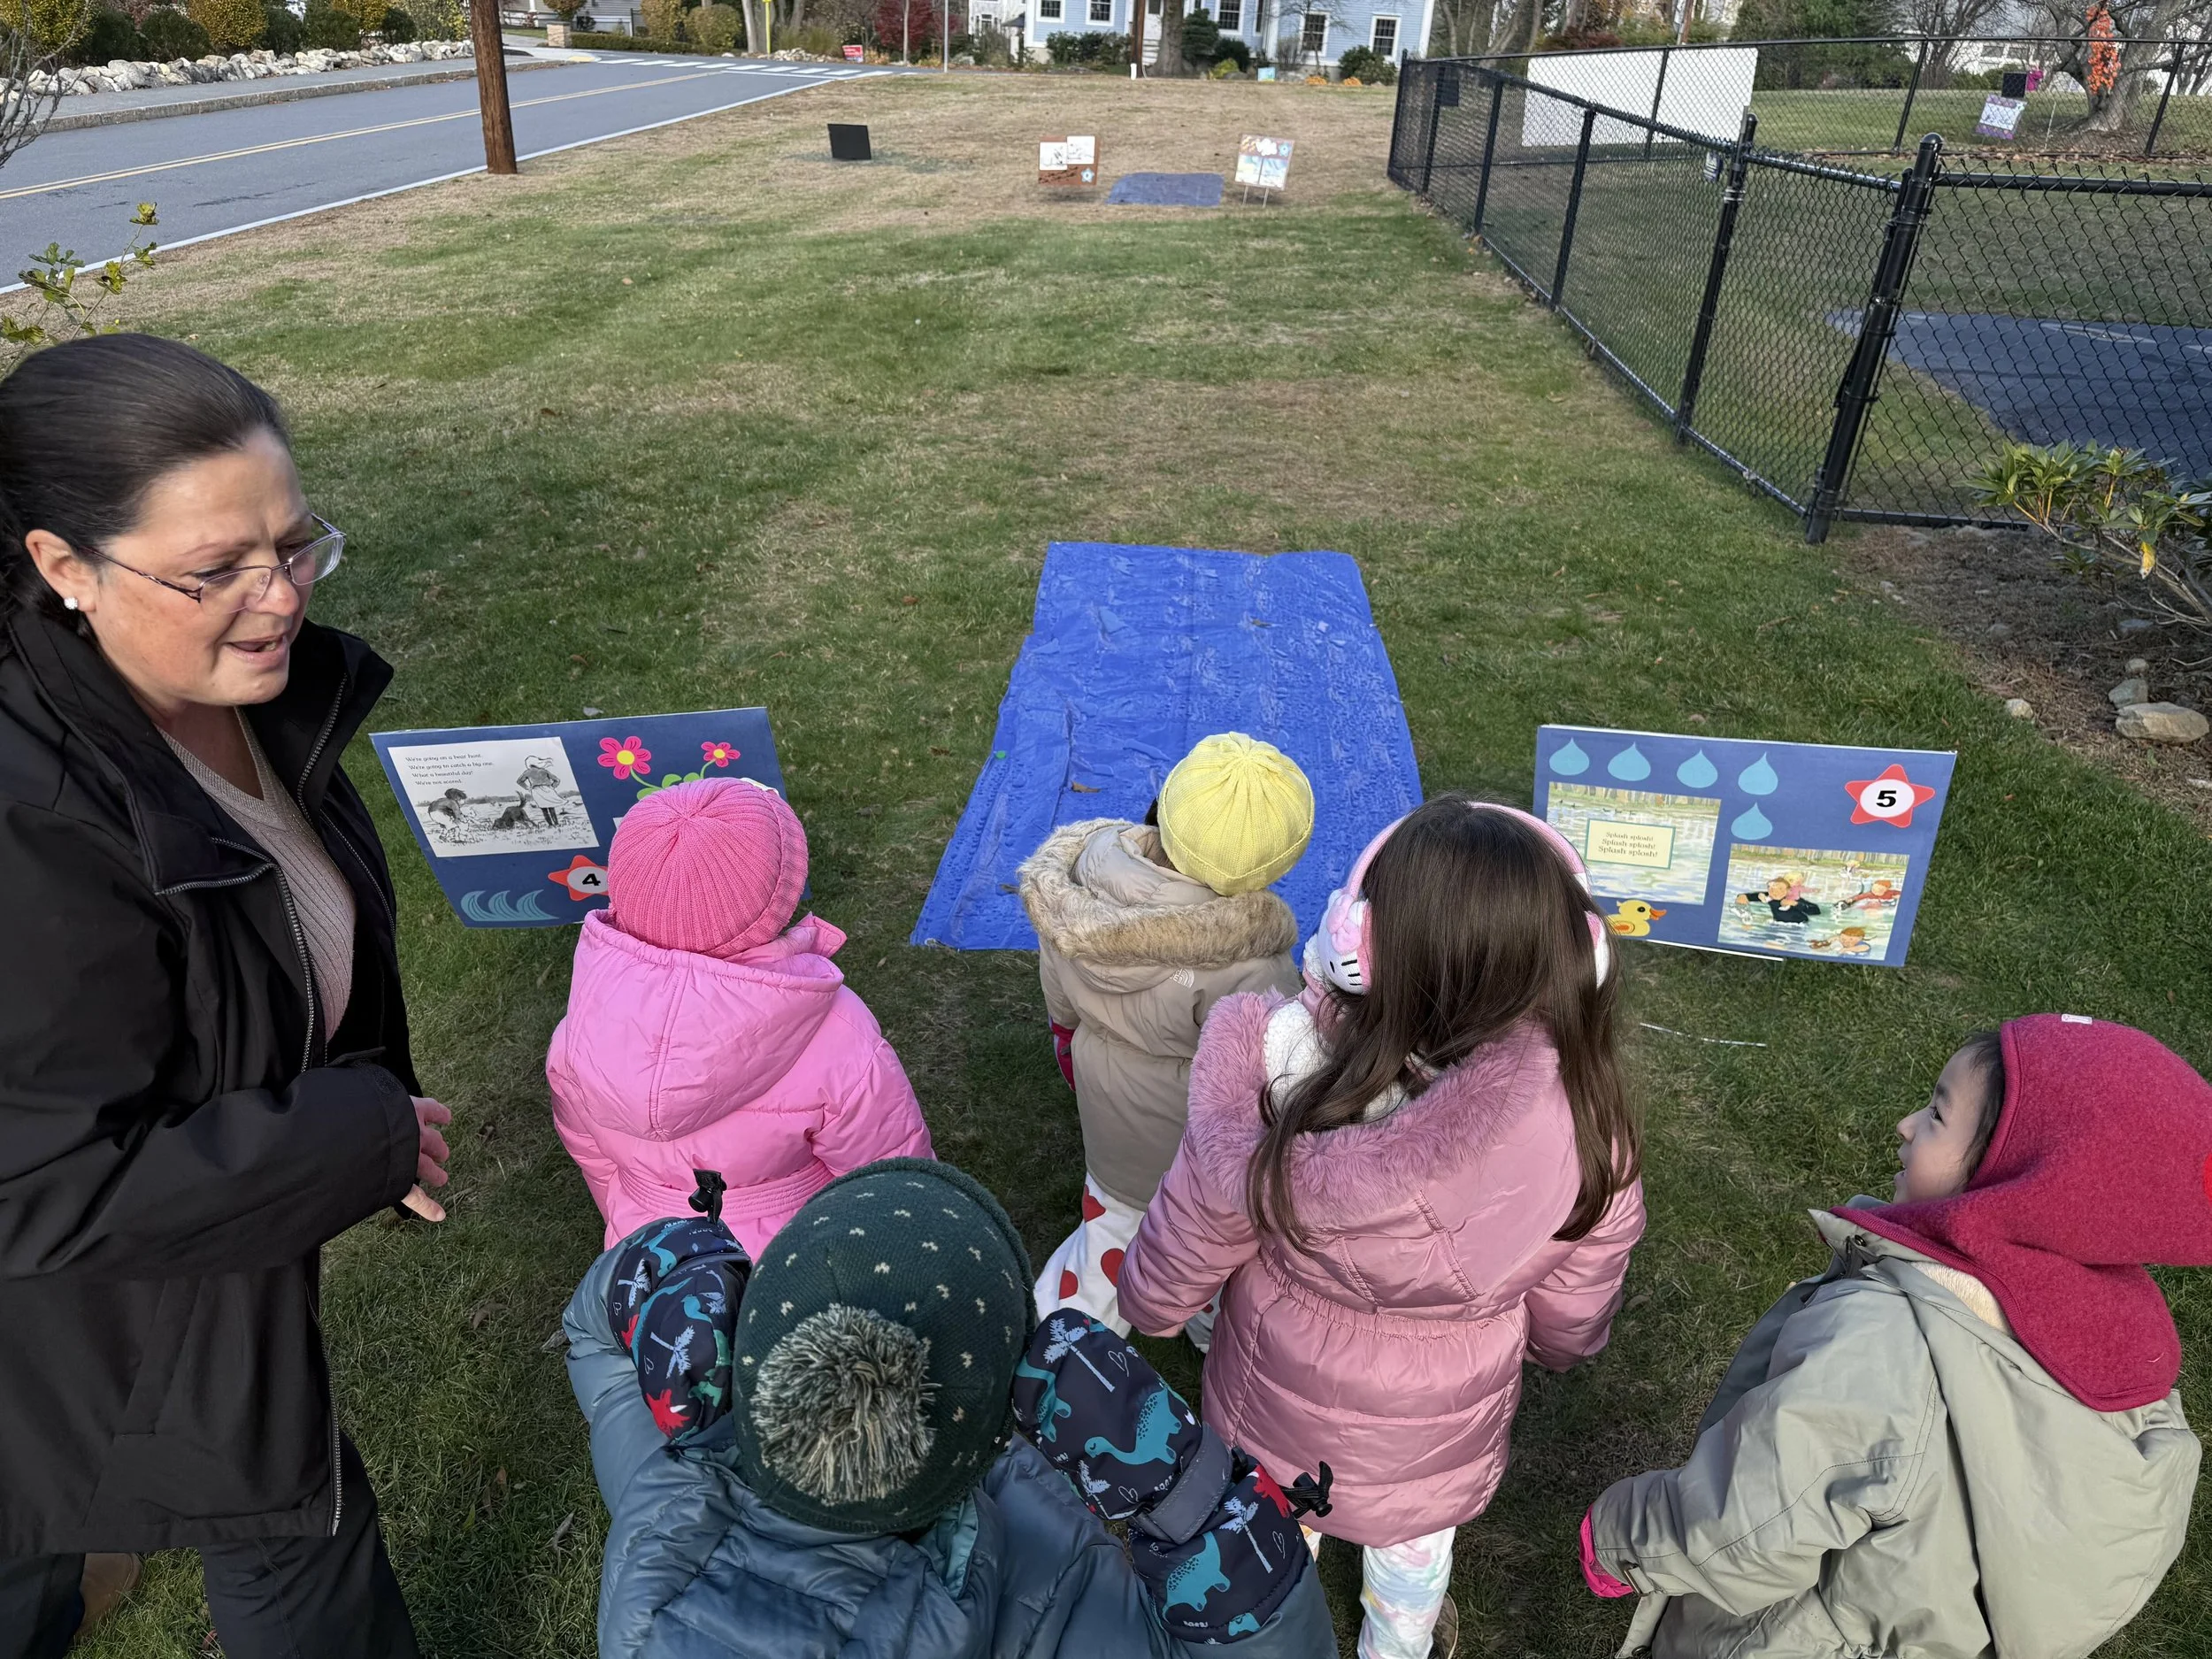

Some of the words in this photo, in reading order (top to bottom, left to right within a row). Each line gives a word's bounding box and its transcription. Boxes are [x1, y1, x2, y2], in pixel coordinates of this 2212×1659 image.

[1876, 790, 1896, 808] 5
[1606, 831, 1628, 840] Splash
[1601, 838, 1627, 847] Splash
[1598, 845, 1626, 854] Splash
[581, 873, 601, 886] 4
